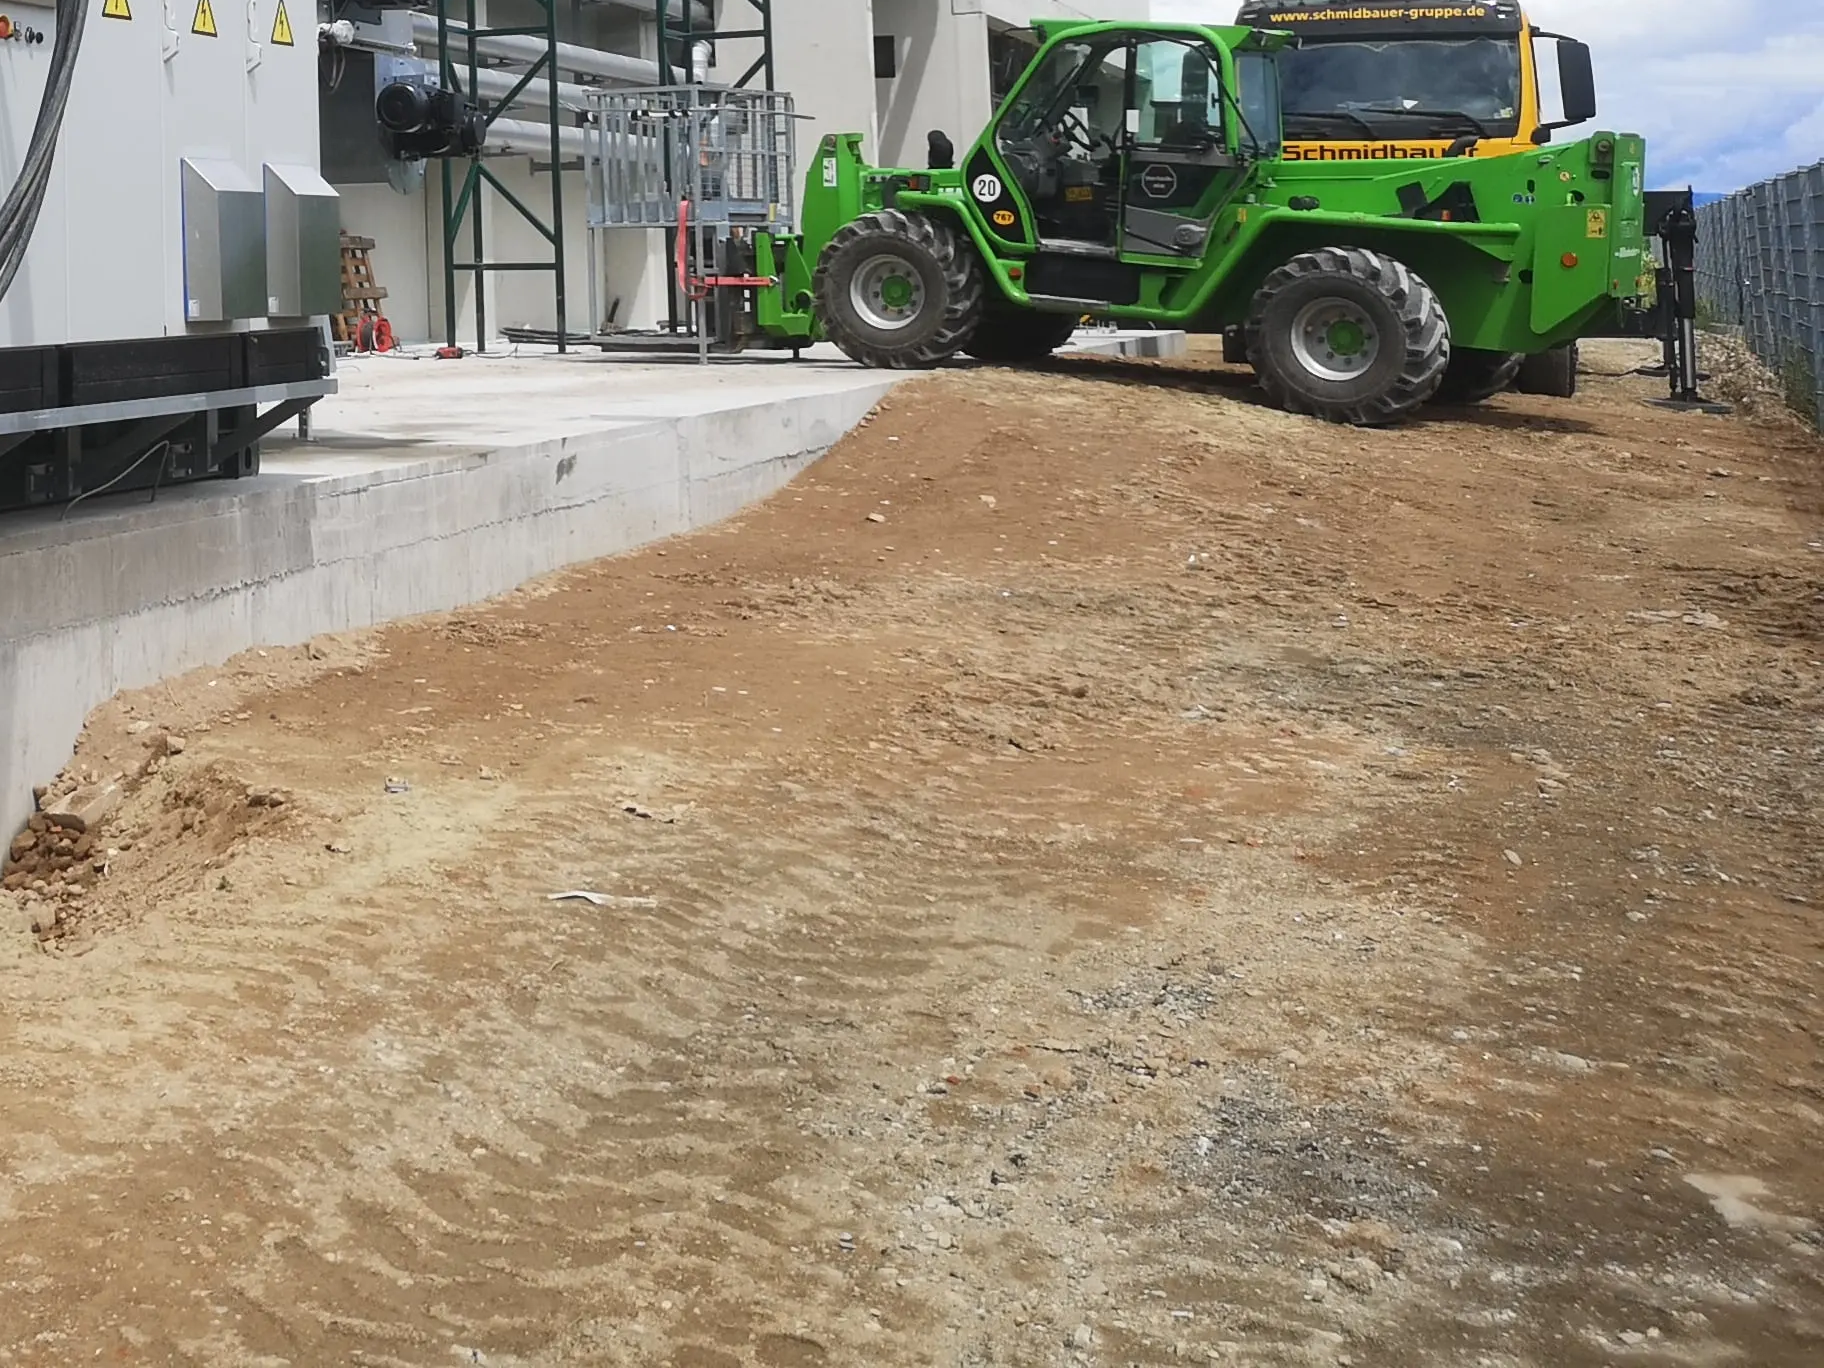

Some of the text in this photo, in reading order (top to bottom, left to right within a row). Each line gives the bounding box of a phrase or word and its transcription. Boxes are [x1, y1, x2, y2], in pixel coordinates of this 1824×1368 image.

[1269, 5, 1485, 22] www.schmidbauer-gruppe.de
[1282, 144, 1479, 161] Schmidbaur
[978, 179, 996, 197] 20
